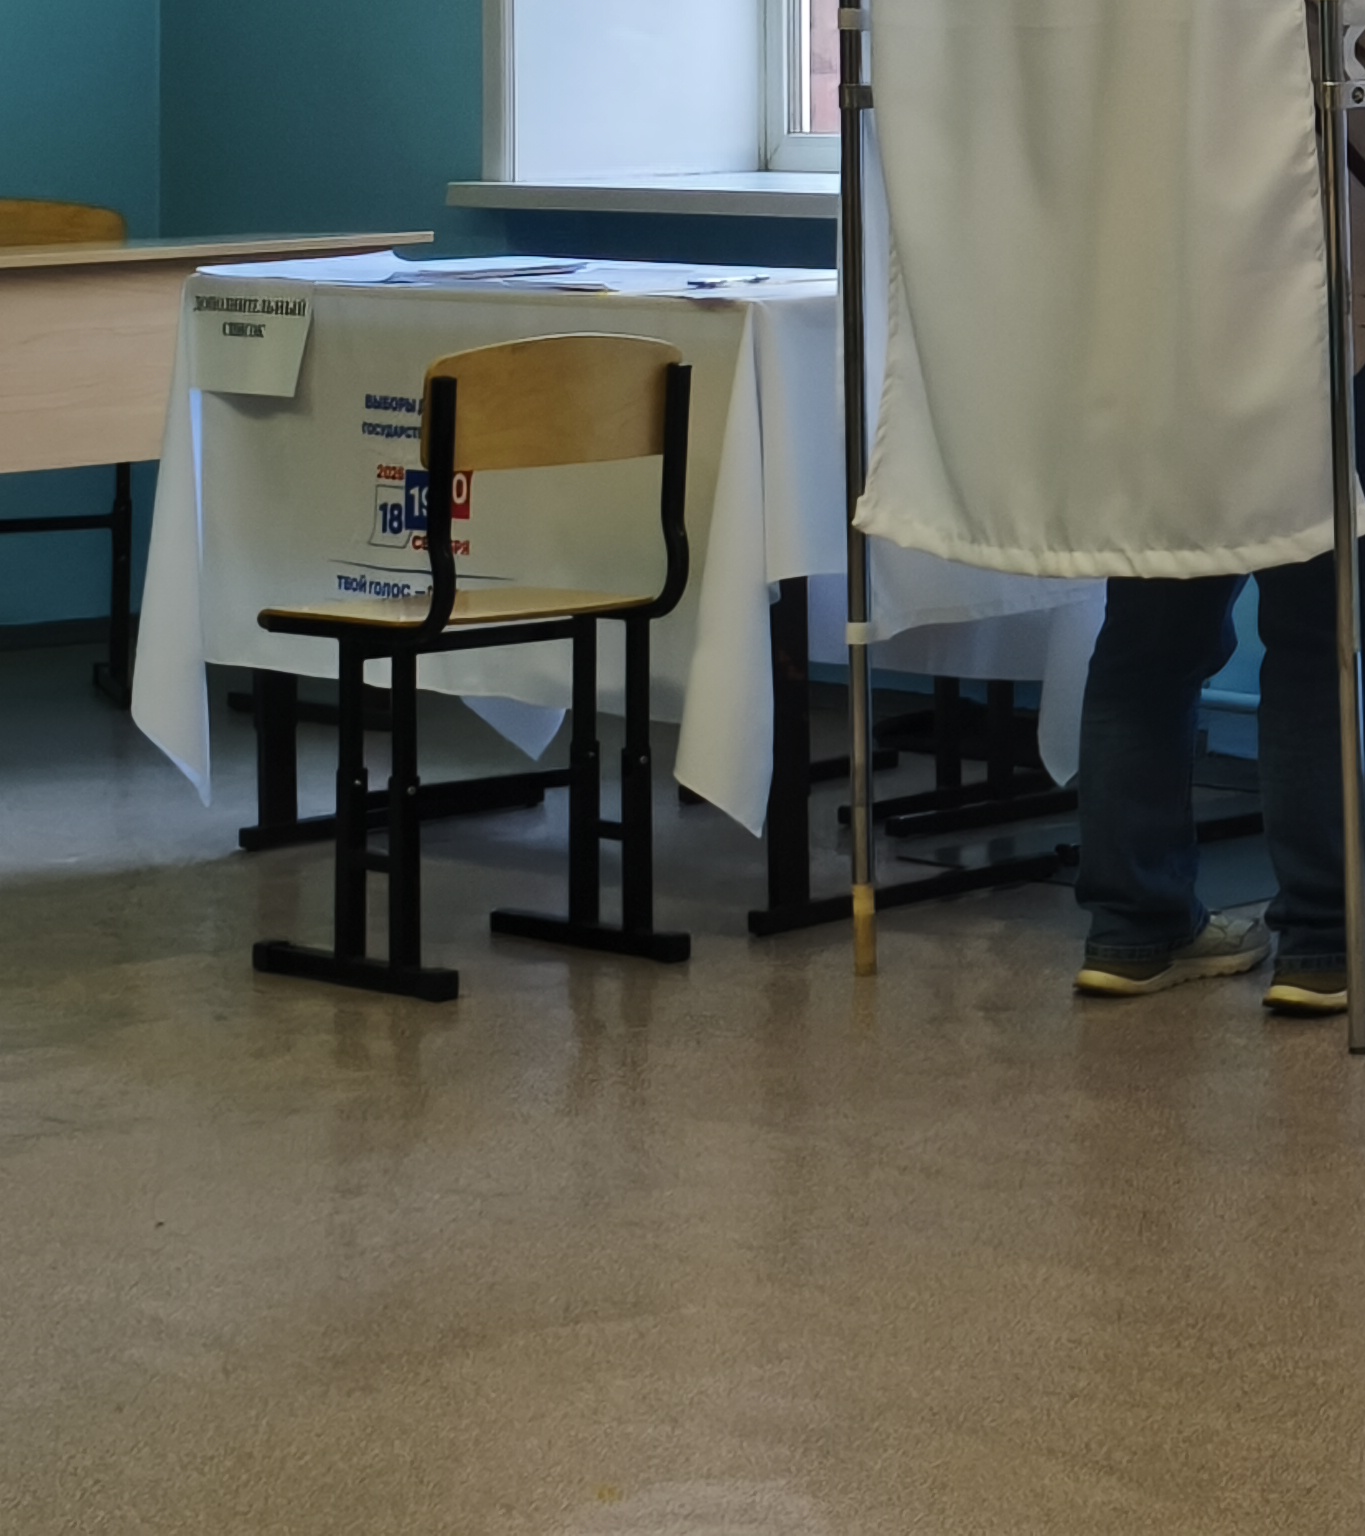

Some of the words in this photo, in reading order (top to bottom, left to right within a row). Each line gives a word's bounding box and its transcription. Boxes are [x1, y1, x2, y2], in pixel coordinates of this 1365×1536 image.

[364, 394, 416, 414] ВЫБОРЫ
[379, 502, 403, 534] 18
[337, 574, 367, 594] ТВОЙ
